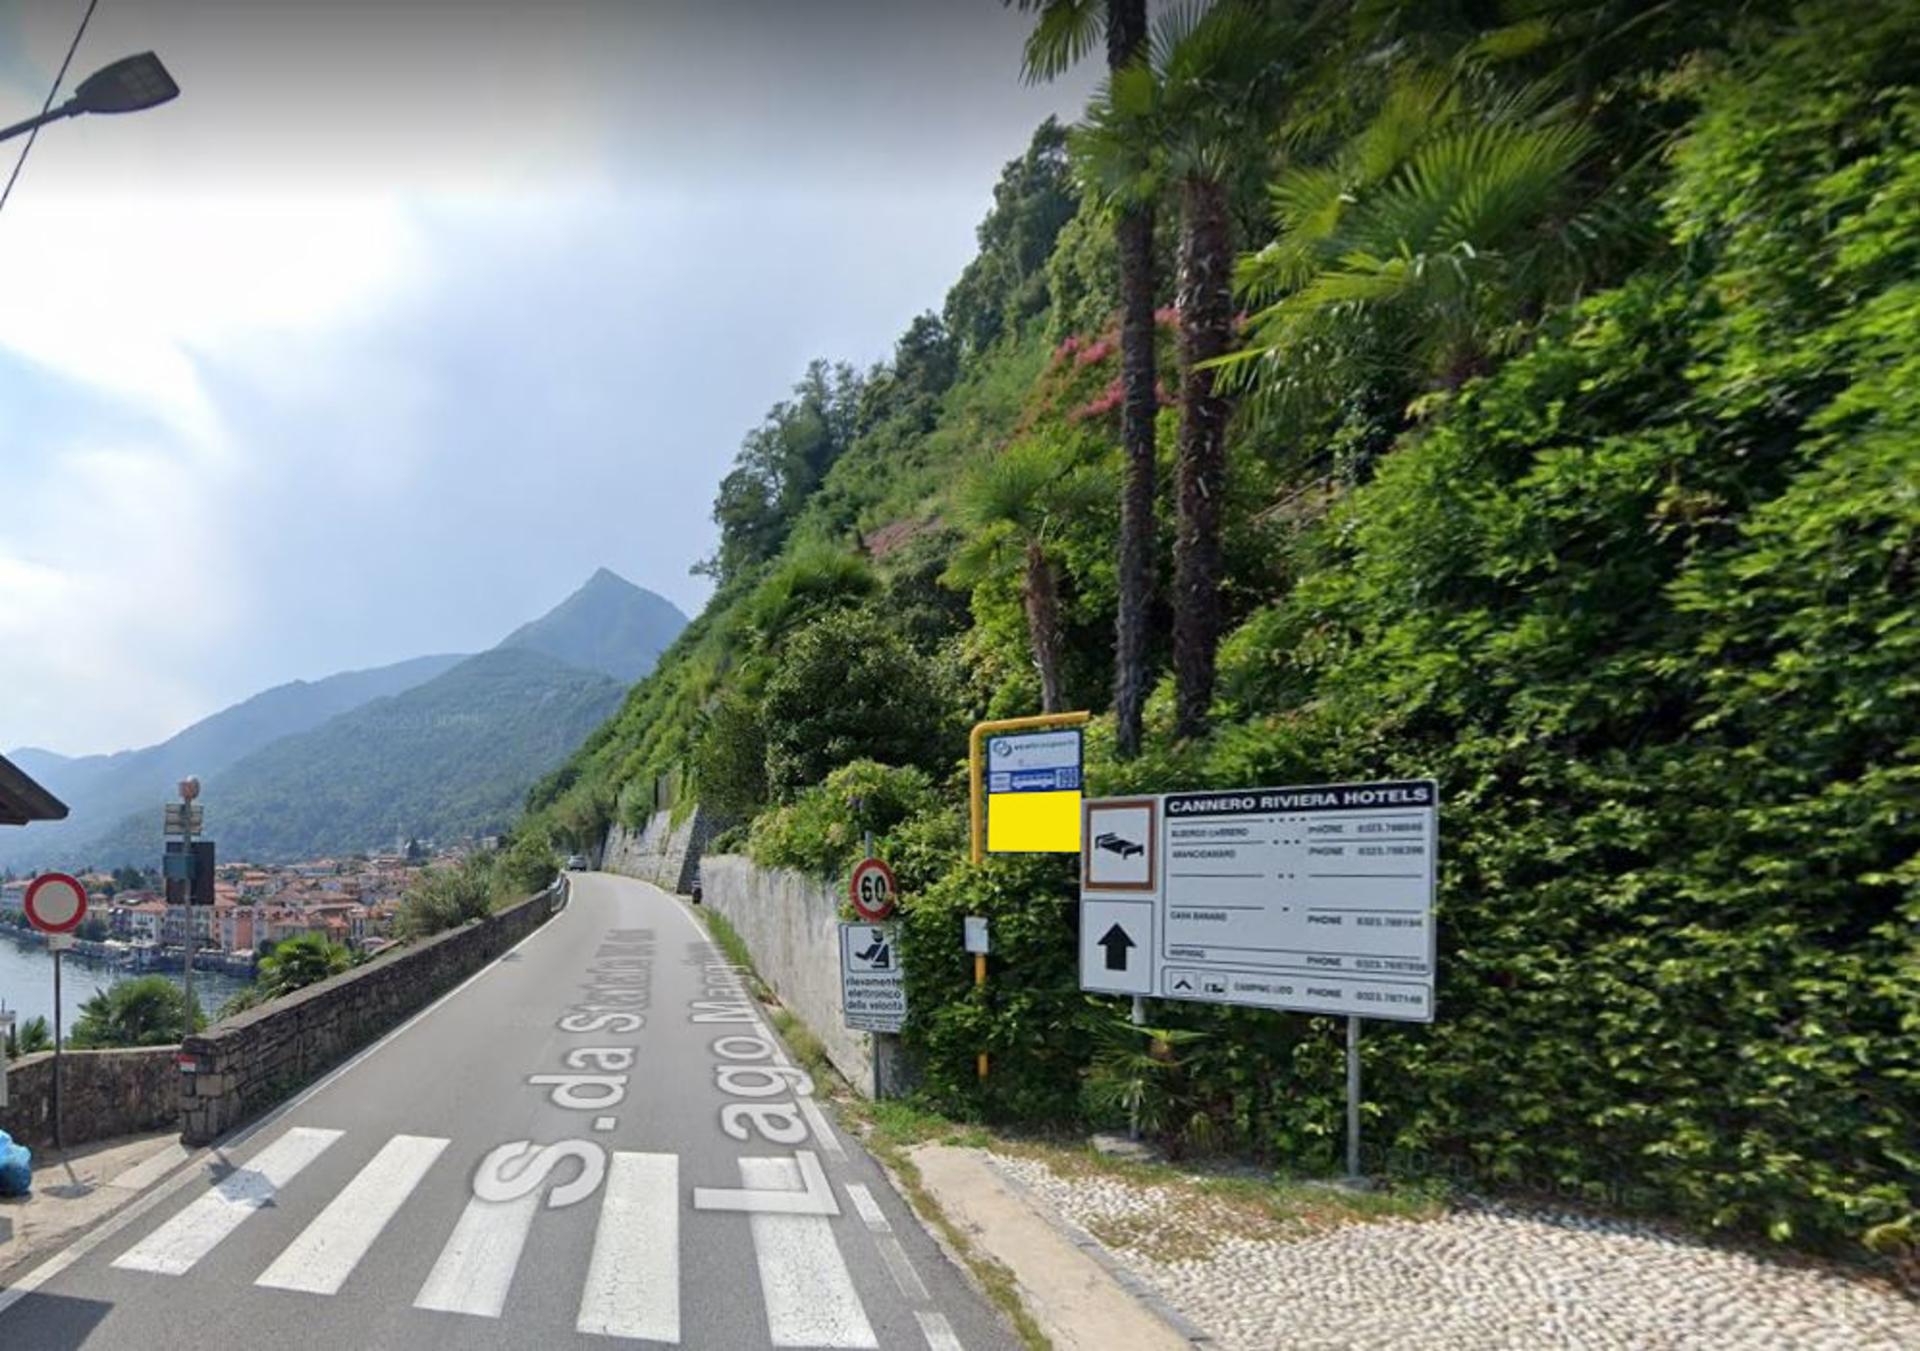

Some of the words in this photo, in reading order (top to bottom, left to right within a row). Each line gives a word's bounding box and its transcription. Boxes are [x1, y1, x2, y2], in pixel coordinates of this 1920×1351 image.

[1169, 798, 1255, 813] CANNERO
[1260, 792, 1339, 809] RIVIERA
[1343, 787, 1429, 805] HOTELS
[1308, 846, 1345, 856] PHONE
[861, 875, 886, 902] 60
[1307, 915, 1342, 925] PHONE
[1306, 956, 1342, 966] PHONE
[846, 976, 897, 987] rilevament
[1306, 987, 1342, 998] PHONE
